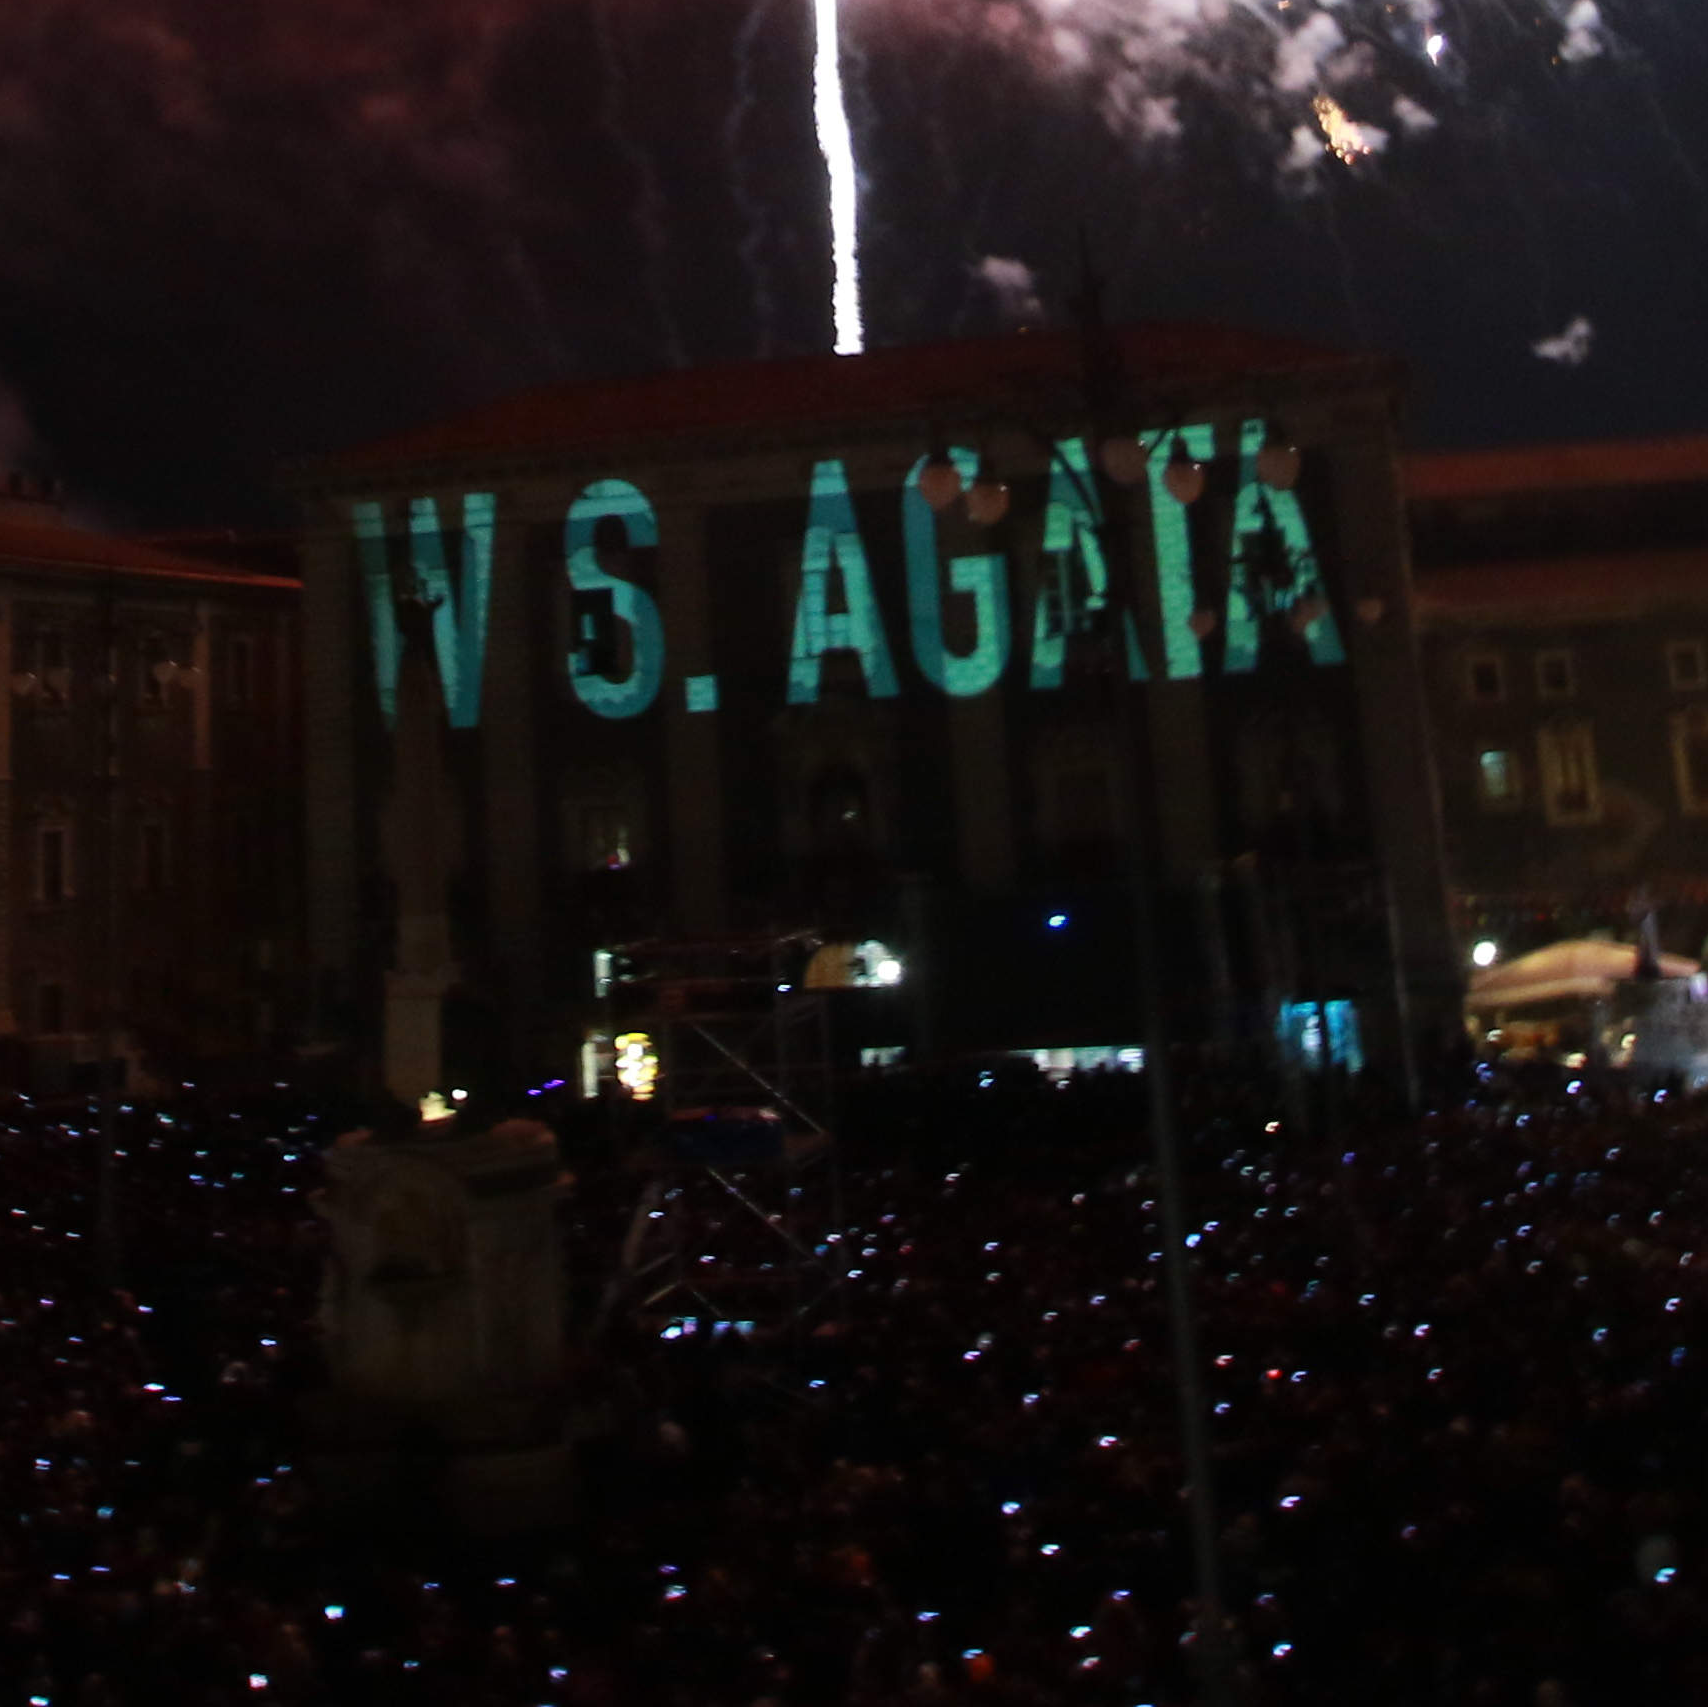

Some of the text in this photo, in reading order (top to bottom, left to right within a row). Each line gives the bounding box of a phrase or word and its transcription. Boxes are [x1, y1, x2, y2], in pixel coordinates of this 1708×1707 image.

[350, 418, 1346, 729] W S. AGATA
